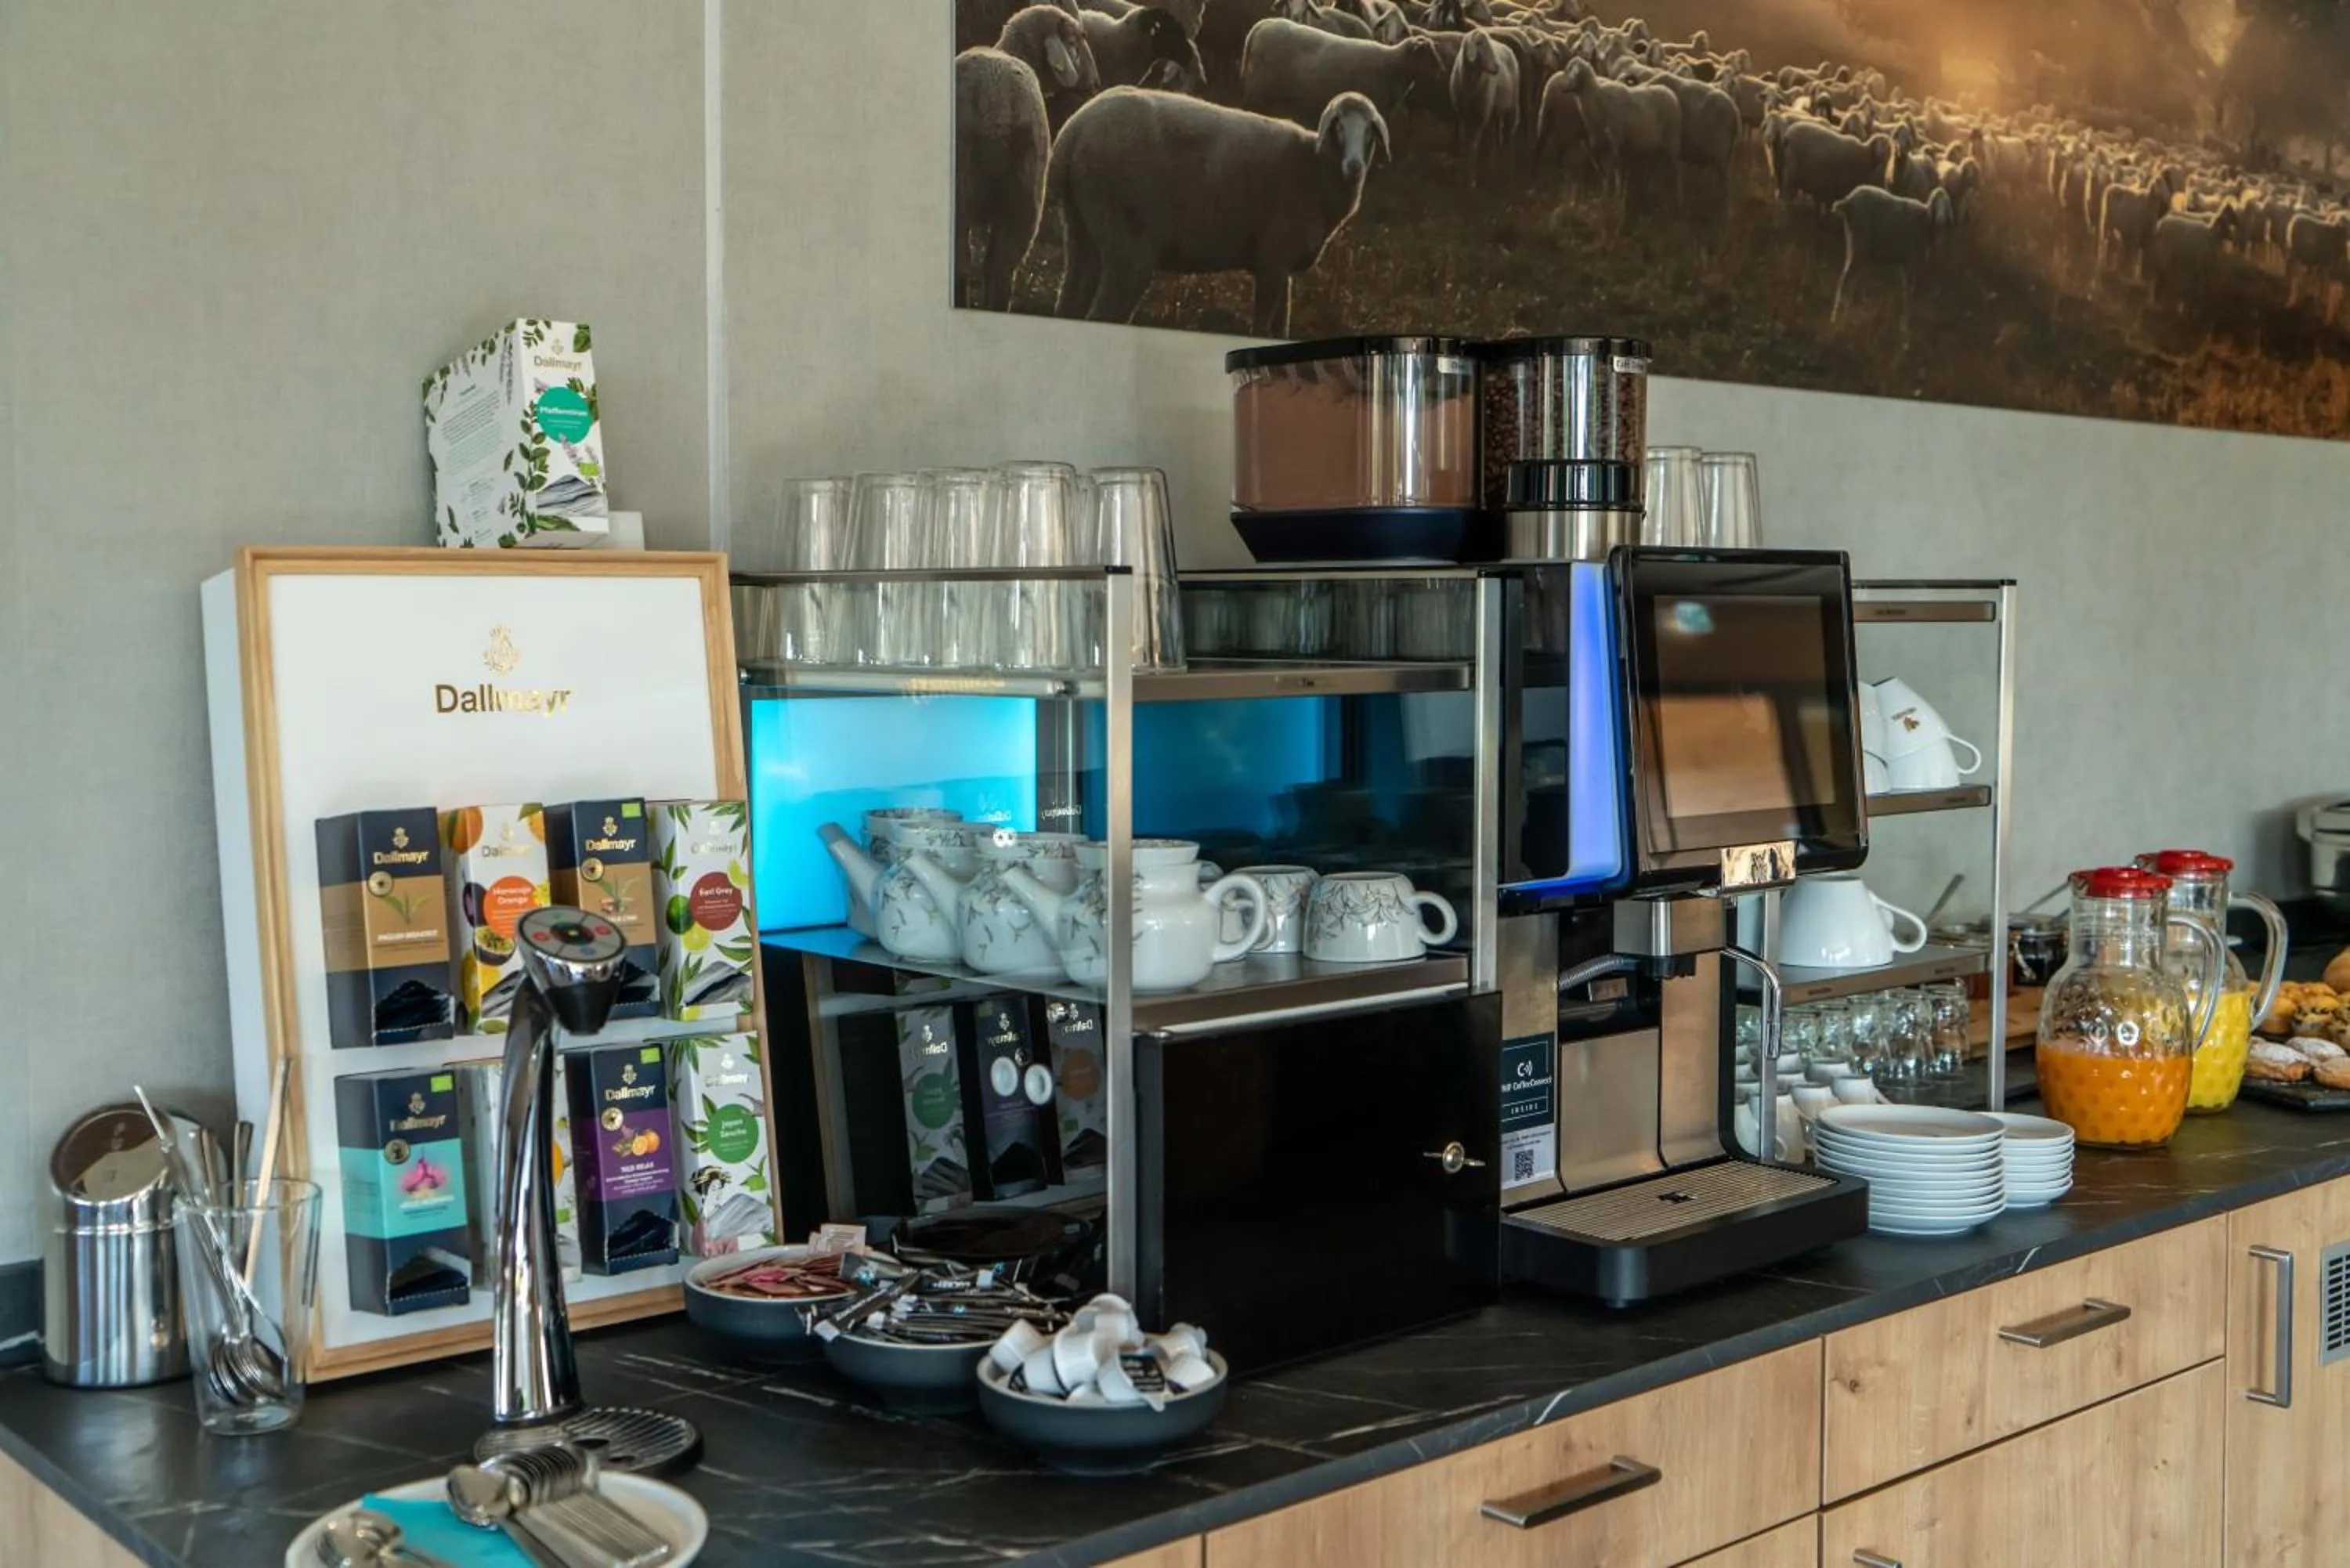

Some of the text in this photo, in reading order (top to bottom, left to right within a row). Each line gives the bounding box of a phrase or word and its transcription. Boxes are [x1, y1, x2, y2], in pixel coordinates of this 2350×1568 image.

[533, 355, 582, 371] Dallmayr
[435, 683, 571, 717] Dallmayr
[584, 838, 637, 851] Dallmayr
[373, 849, 429, 865] Dallmayr
[699, 887, 733, 898] Earl Grey
[1513, 1075, 1552, 1091] CoffeeConnect
[606, 1084, 656, 1102] Dallmayr
[1511, 1103, 1538, 1115] INSIDE
[389, 1114, 448, 1133] Dallmayr
